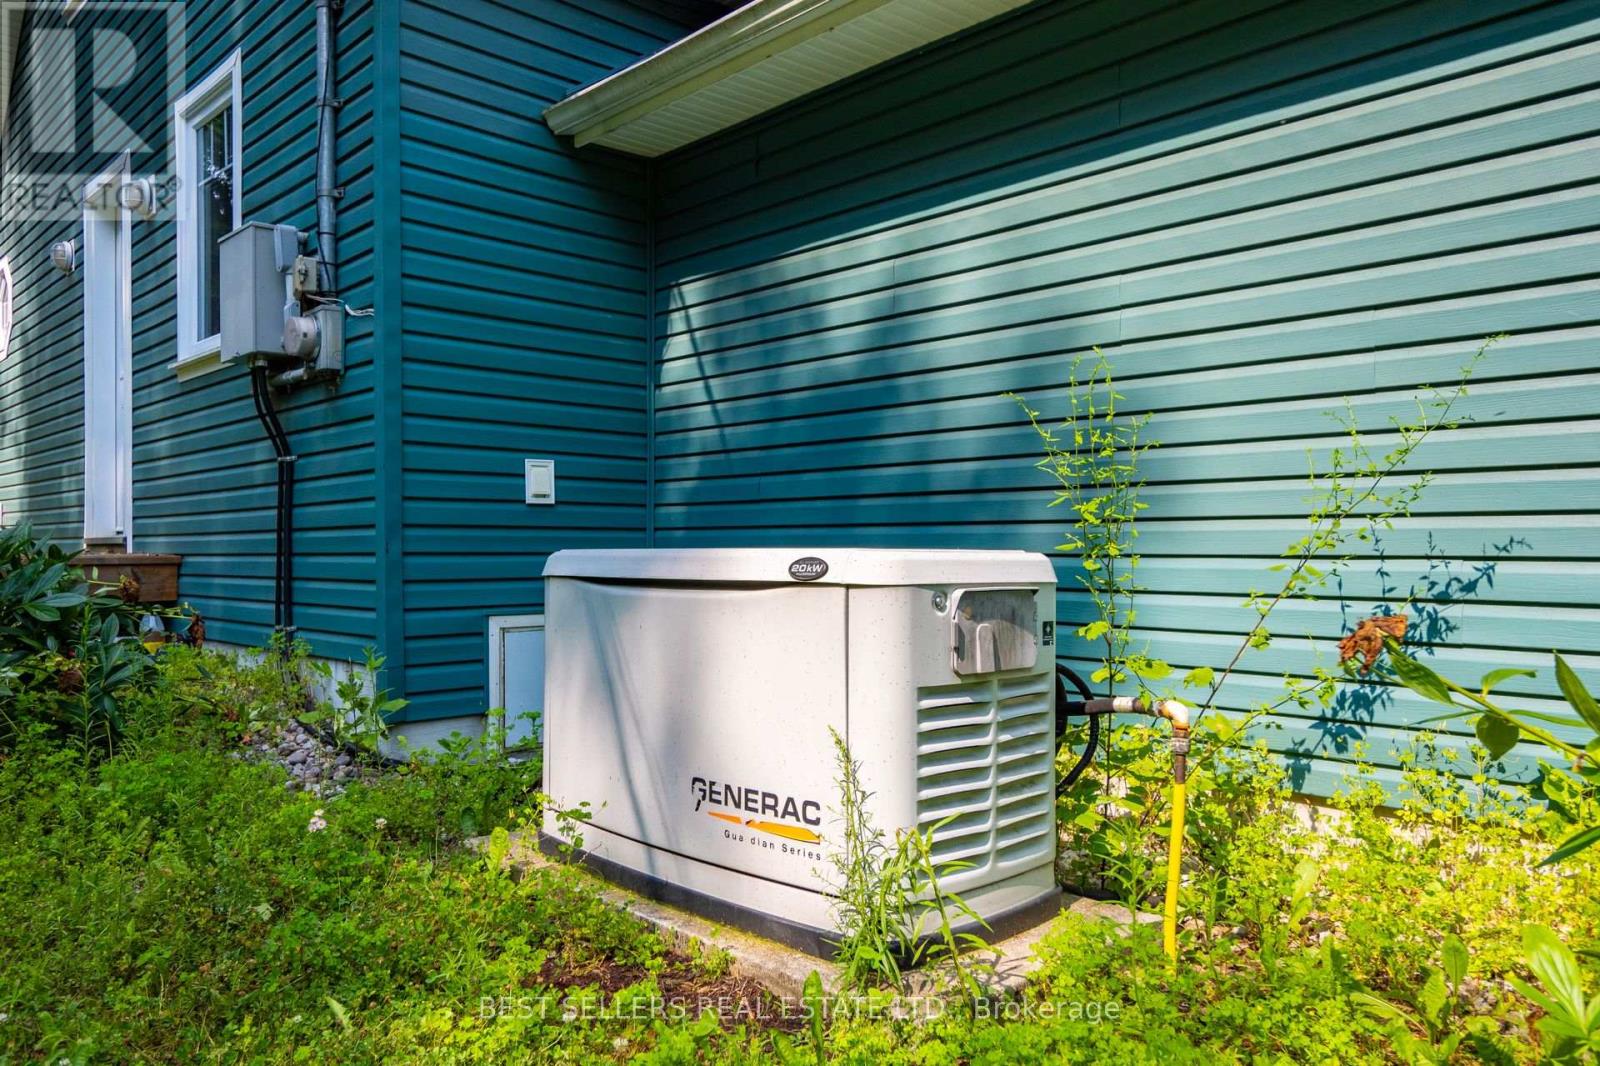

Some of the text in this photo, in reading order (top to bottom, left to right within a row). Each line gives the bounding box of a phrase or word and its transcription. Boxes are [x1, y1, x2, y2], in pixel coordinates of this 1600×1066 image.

[691, 776, 821, 826] GENERAC
[724, 829, 821, 861] Guadian Series
